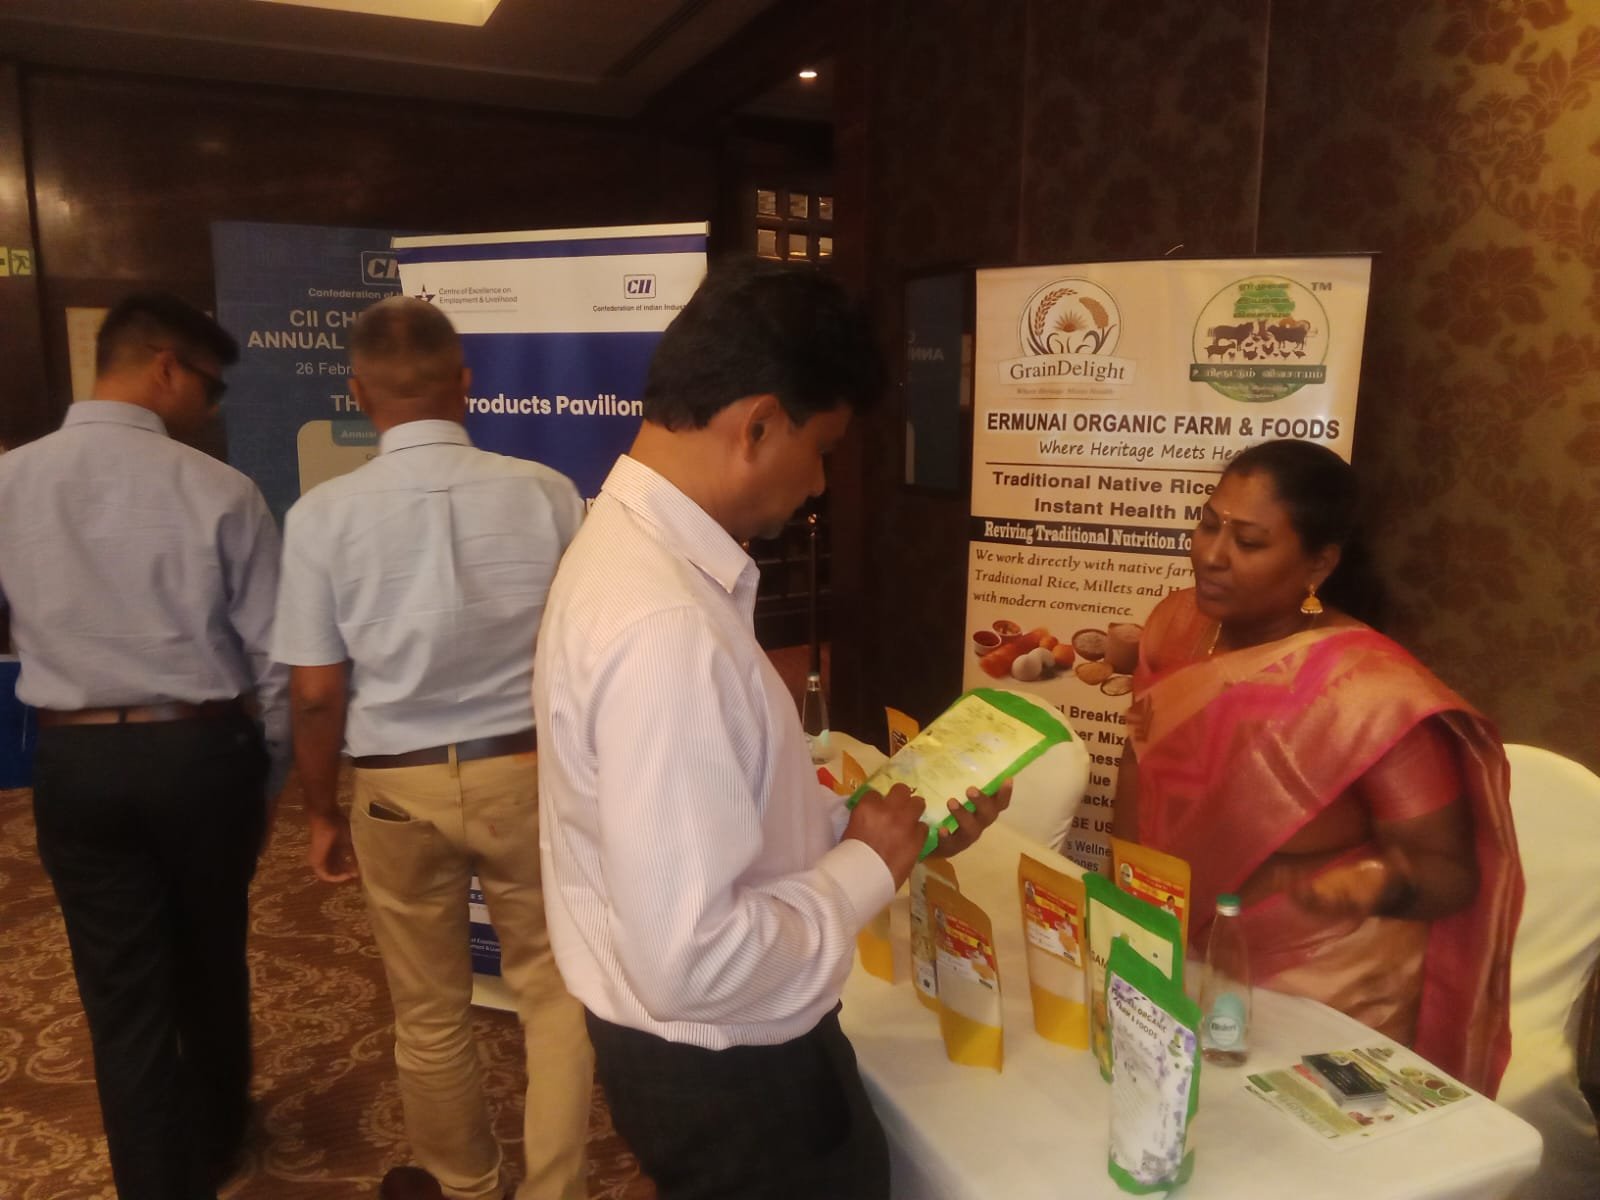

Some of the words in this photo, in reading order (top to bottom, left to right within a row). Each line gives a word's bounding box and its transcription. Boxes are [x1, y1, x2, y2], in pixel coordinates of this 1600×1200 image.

[367, 258, 400, 279] CI
[308, 287, 381, 299] Confederation
[438, 287, 459, 295] Centre
[459, 287, 468, 295] of
[468, 287, 502, 295] Excellence
[627, 279, 652, 294] CII
[1310, 281, 1333, 291] TM
[439, 296, 478, 304] Employment
[485, 296, 518, 304] Livelihood
[592, 304, 635, 313] Confederation
[635, 304, 642, 312] of
[289, 309, 318, 327] CII
[247, 331, 345, 350] ANNUAL
[295, 362, 314, 375] 26
[319, 362, 352, 376] Febr
[1010, 360, 1125, 382] GrainDelight
[329, 394, 360, 412] TH
[465, 393, 551, 415] roducts
[556, 393, 643, 417] Pavilion
[987, 413, 1067, 431] ERMUNAI
[1073, 413, 1166, 434] ORGANIC
[1173, 415, 1232, 436] FARM
[1239, 417, 1253, 436] &
[1261, 418, 1341, 440] FOODS
[1039, 440, 1084, 455] Where
[1090, 441, 1154, 462] Heritage
[1160, 444, 1206, 460] Meets
[1212, 445, 1246, 461] Hea
[993, 471, 1091, 490] Traditional
[1097, 475, 1163, 493] Native
[1170, 478, 1216, 496] Rice
[1034, 498, 1104, 516] Instant
[1110, 502, 1176, 520] Health
[1184, 505, 1203, 521] M
[984, 520, 1034, 544] Reviving
[1035, 524, 1109, 546] Traditional
[1112, 528, 1176, 550] Nutrition
[1177, 533, 1193, 551] fo
[975, 548, 994, 562] We
[995, 550, 1025, 565] work
[1027, 552, 1080, 571] directly
[1084, 556, 1115, 572] with
[1118, 561, 1163, 576] native
[975, 569, 1043, 587] Traditional
[1047, 576, 1080, 592] Rice,
[1083, 579, 1133, 595] Millets
[1136, 583, 1163, 598] and
[973, 591, 997, 604] with
[998, 594, 1047, 609] modern
[1050, 600, 1134, 617] convenience.
[1070, 706, 1127, 725] Breakfa
[1089, 753, 1121, 767] ness
[1089, 772, 1111, 786] lue
[1071, 816, 1089, 830] SE
[1075, 840, 1112, 857] Wellne
